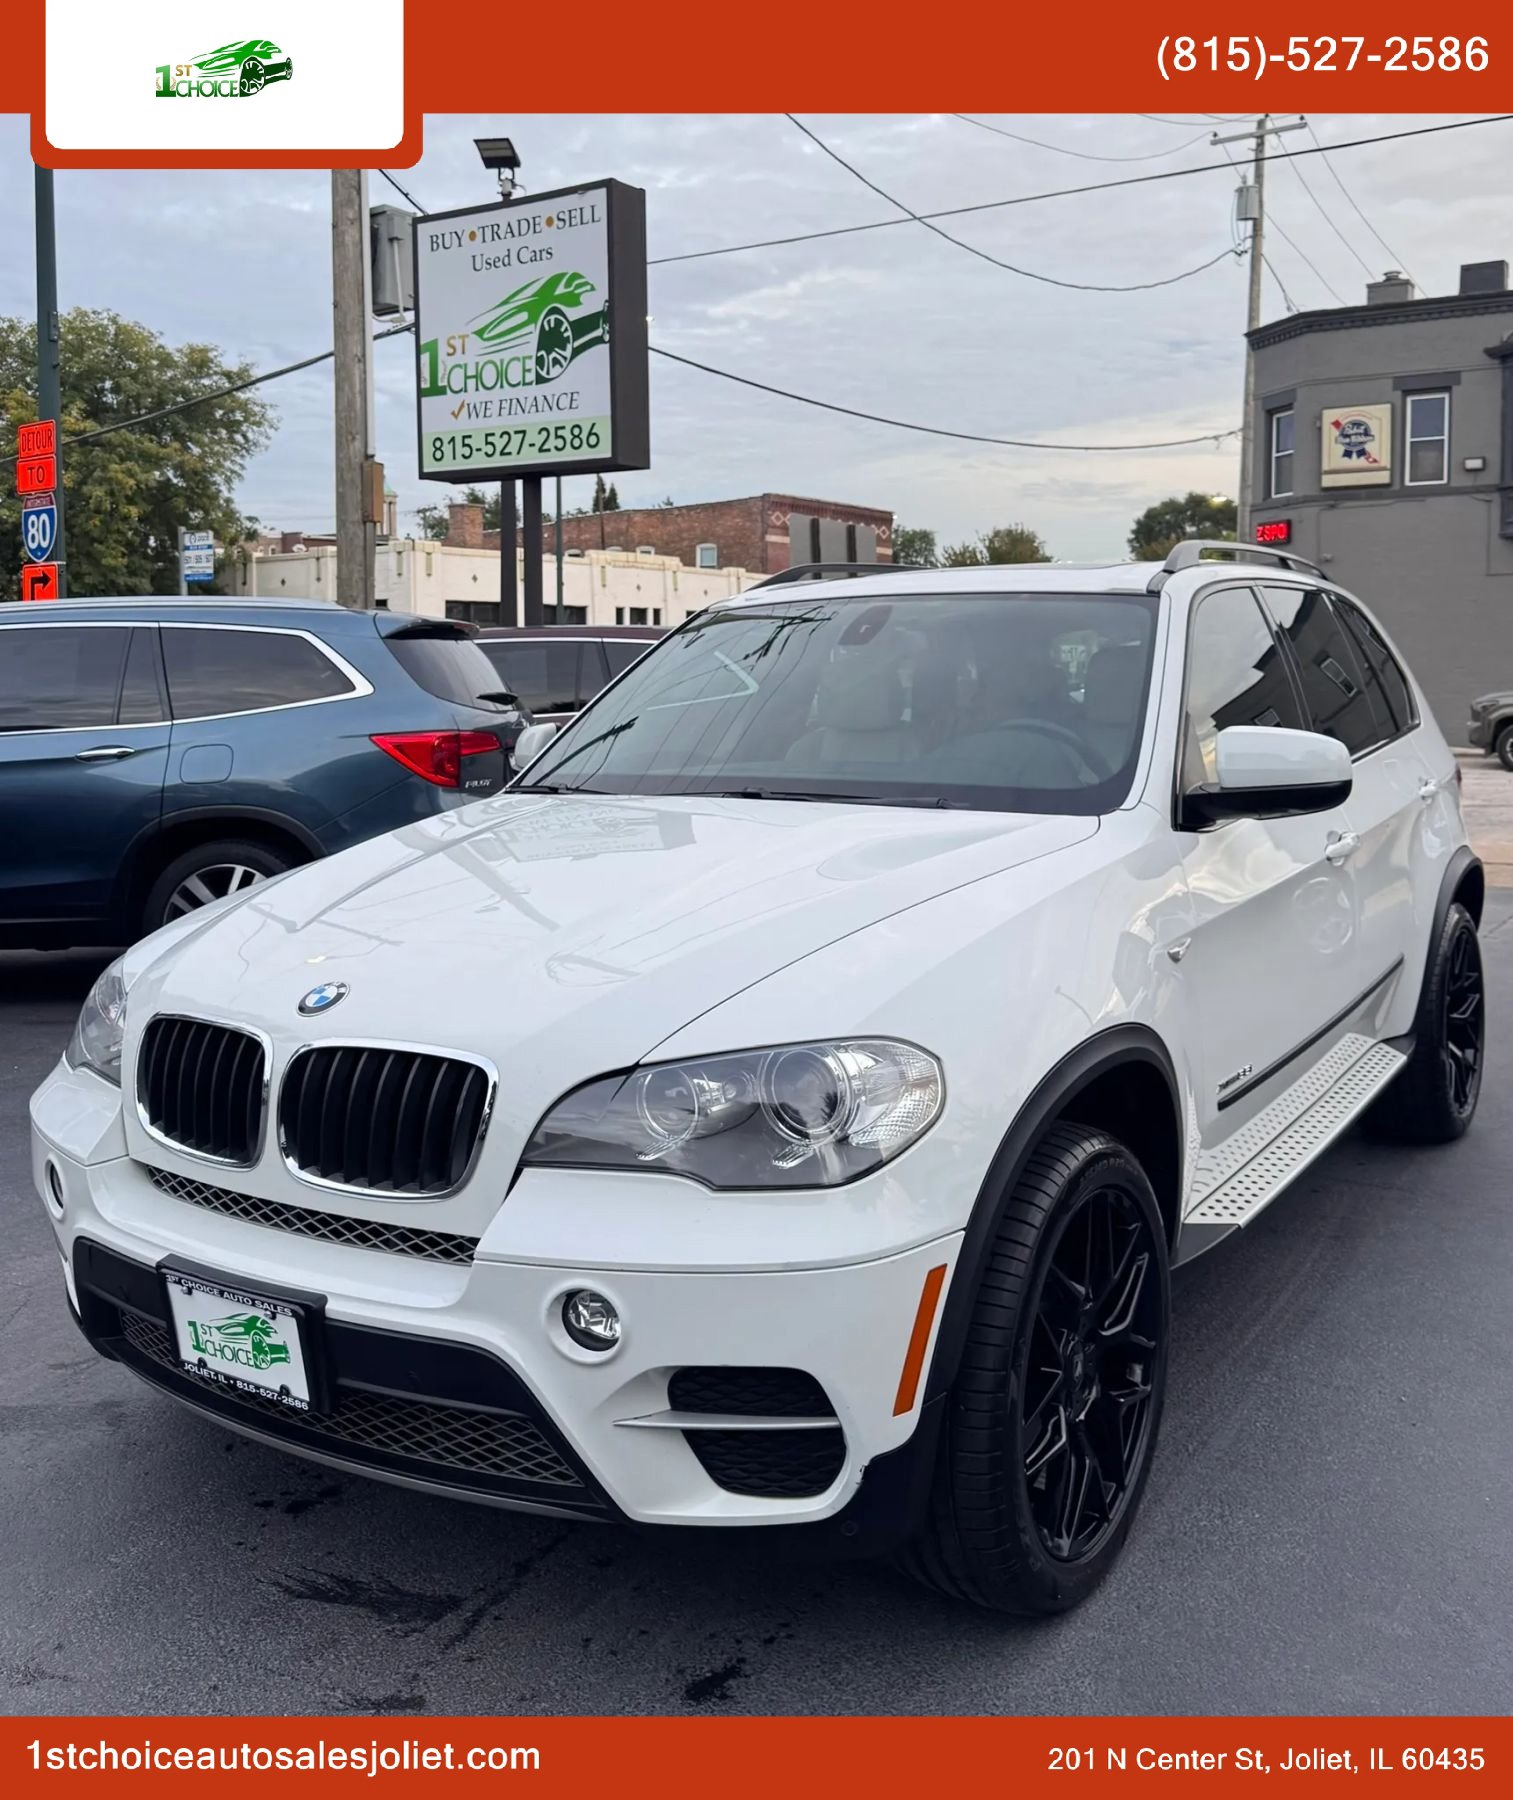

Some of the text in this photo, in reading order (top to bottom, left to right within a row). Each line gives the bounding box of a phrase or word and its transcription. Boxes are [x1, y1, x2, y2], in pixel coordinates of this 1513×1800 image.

[429, 204, 601, 253] BUY TRADE SELL
[471, 245, 553, 272] Used Cars
[447, 355, 534, 394] CHOICE
[466, 391, 580, 421] WE FINANCE
[21, 428, 53, 453] DETOUR
[432, 422, 600, 462] 815-527-2586
[27, 465, 46, 486] TO
[27, 512, 51, 550] 80
[181, 1278, 221, 1298] CHOICE
[223, 1291, 253, 1306] AUTO
[254, 1300, 293, 1317] SALES
[203, 1340, 256, 1368] CHOICE
[218, 1373, 229, 1384] IL
[236, 1380, 309, 1411] 815-527-2586
